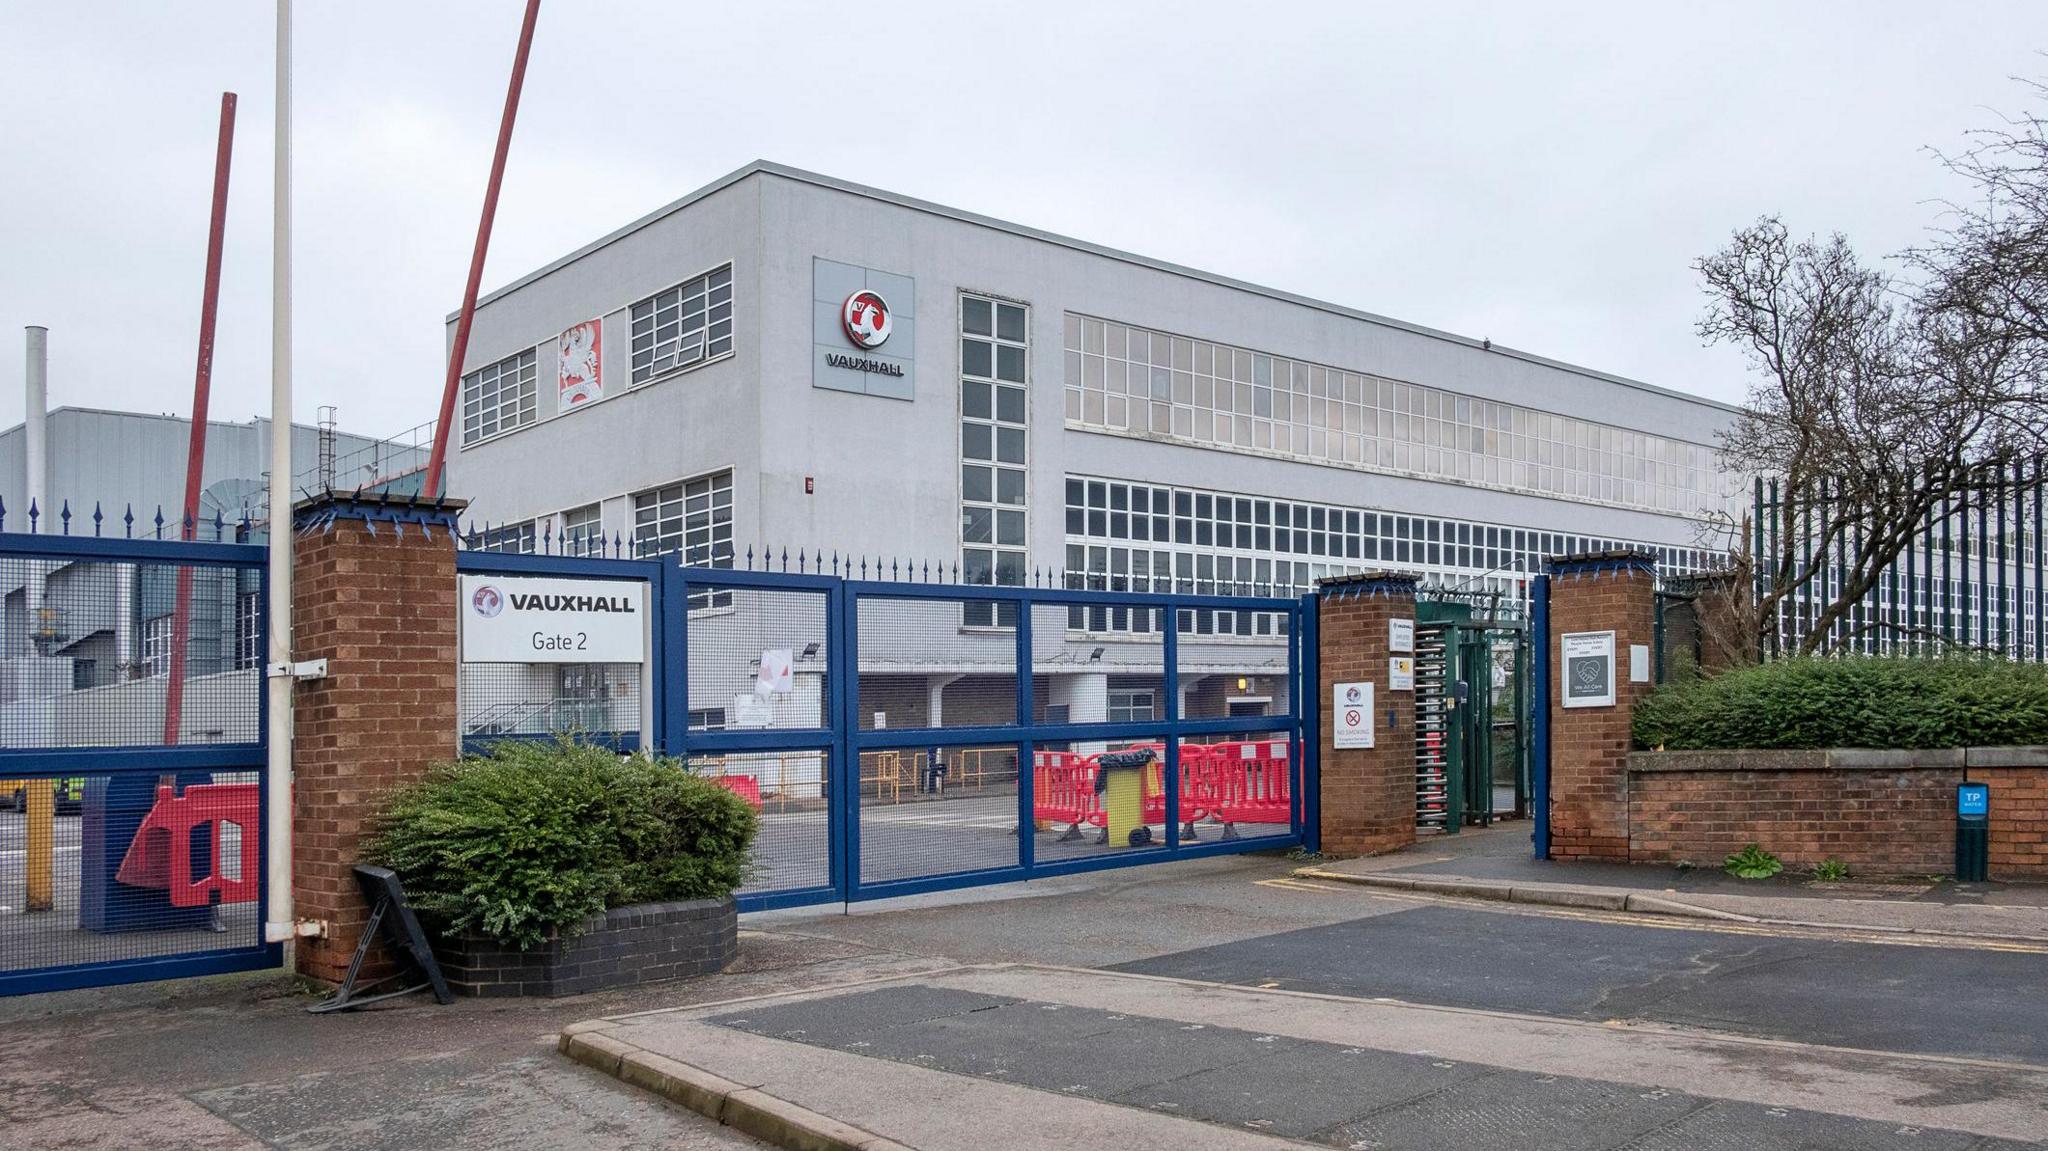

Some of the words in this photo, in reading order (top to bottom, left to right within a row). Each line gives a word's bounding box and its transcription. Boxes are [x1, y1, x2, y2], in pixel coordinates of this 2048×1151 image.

[825, 353, 904, 377] VAUXHALL
[510, 594, 635, 613] VAUXHALL
[532, 631, 572, 650] Gate
[577, 632, 587, 650] 2
[1965, 793, 1981, 801] TP
